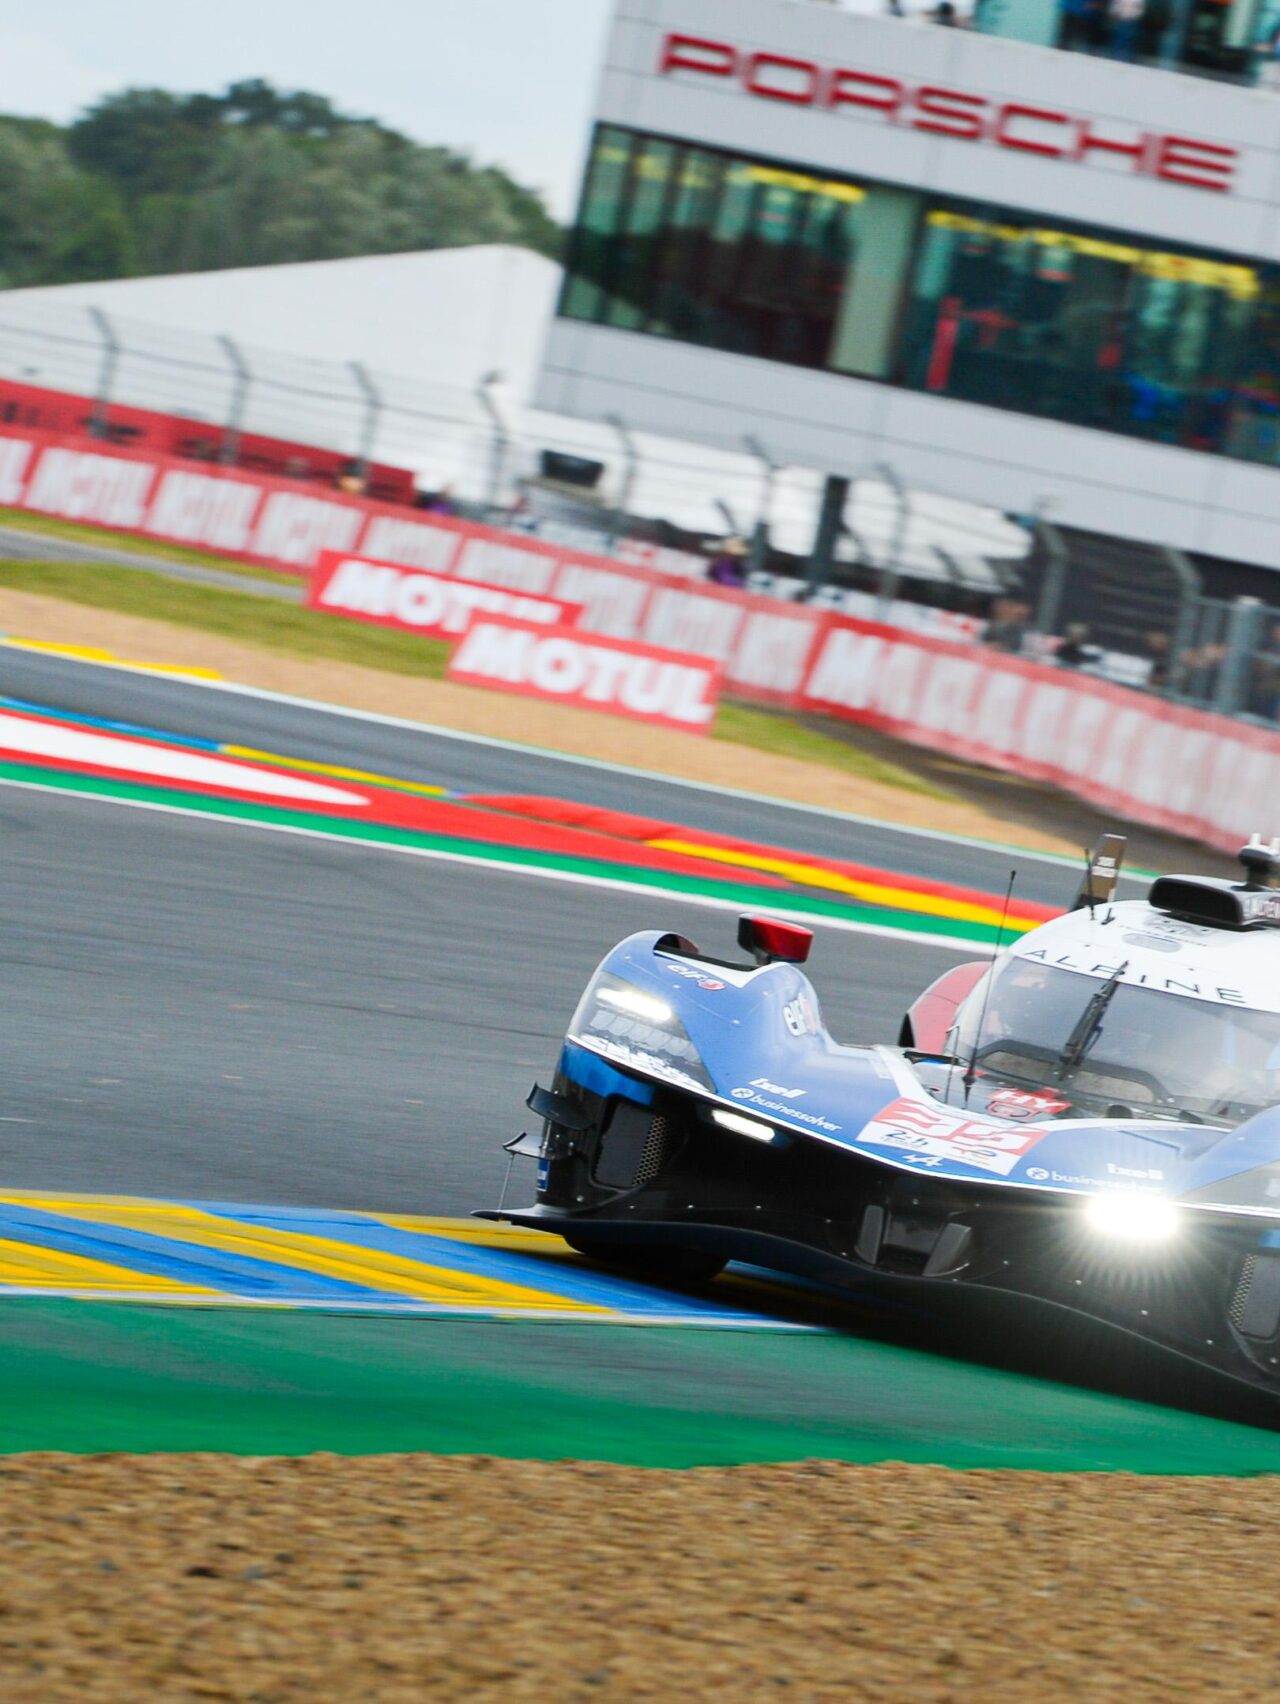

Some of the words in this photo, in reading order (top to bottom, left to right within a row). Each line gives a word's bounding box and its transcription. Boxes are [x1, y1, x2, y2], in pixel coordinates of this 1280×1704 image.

[660, 33, 1239, 193] PORSCHE
[449, 623, 716, 724] MOTUL
[1025, 949, 1246, 1004] ALPINE
[749, 1093, 843, 1132] businessolver
